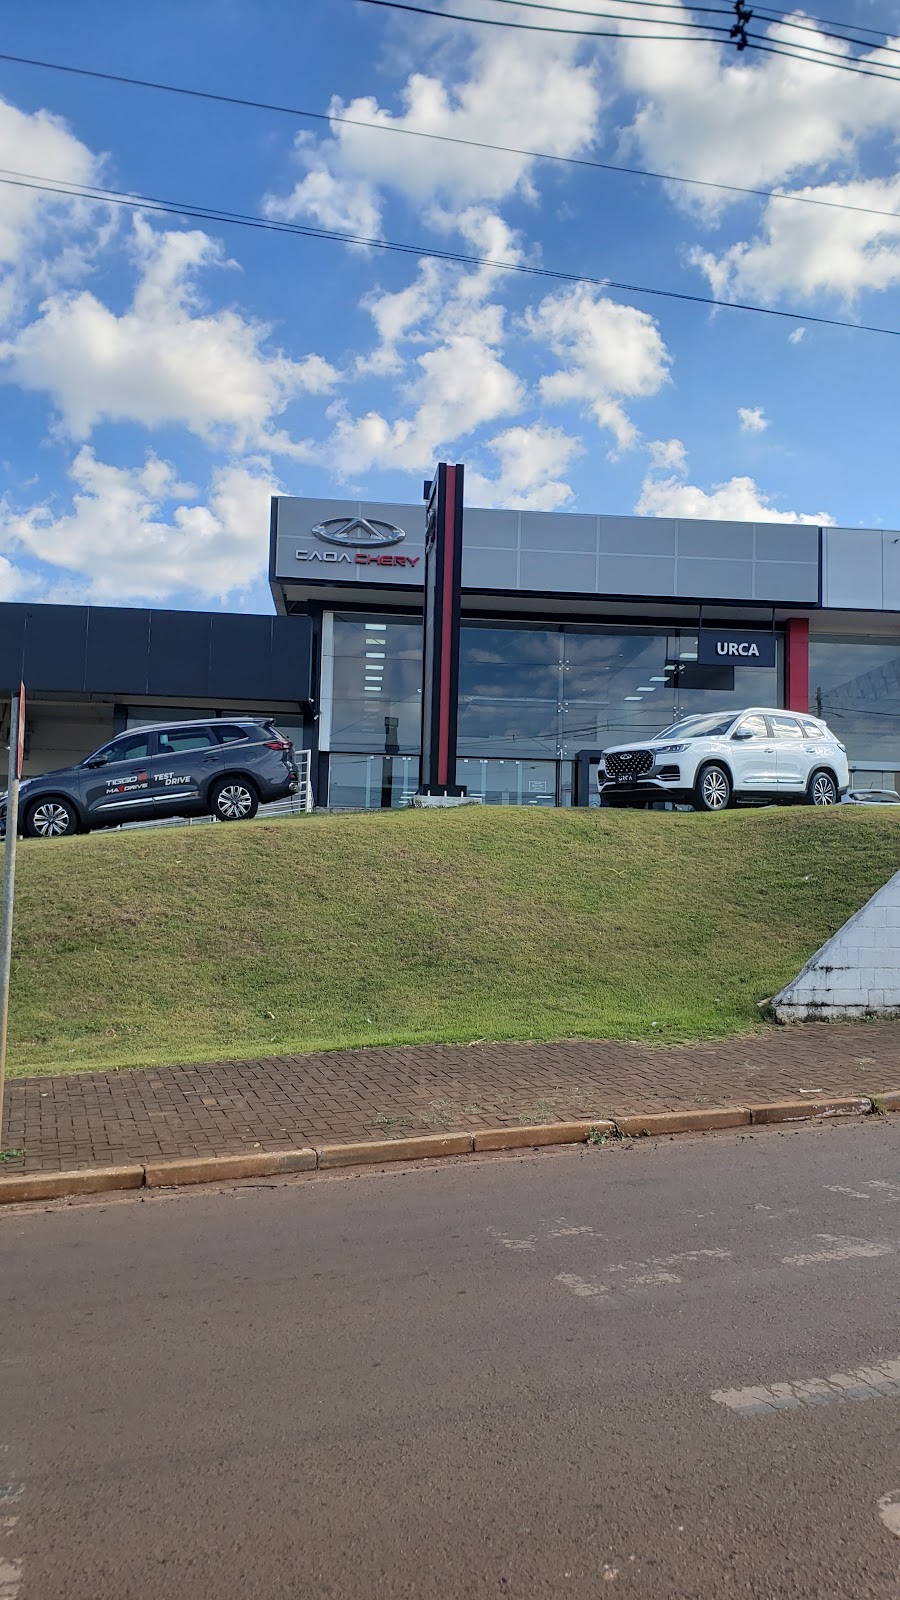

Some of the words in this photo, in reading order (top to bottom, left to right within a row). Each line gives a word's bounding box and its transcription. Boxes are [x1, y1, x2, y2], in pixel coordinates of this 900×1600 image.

[295, 549, 351, 563] CAOA
[354, 553, 420, 567] CHERY
[717, 642, 759, 656] URCA
[105, 776, 138, 786] TIGGO
[153, 772, 175, 781] TEST
[165, 775, 191, 786] DRIVE
